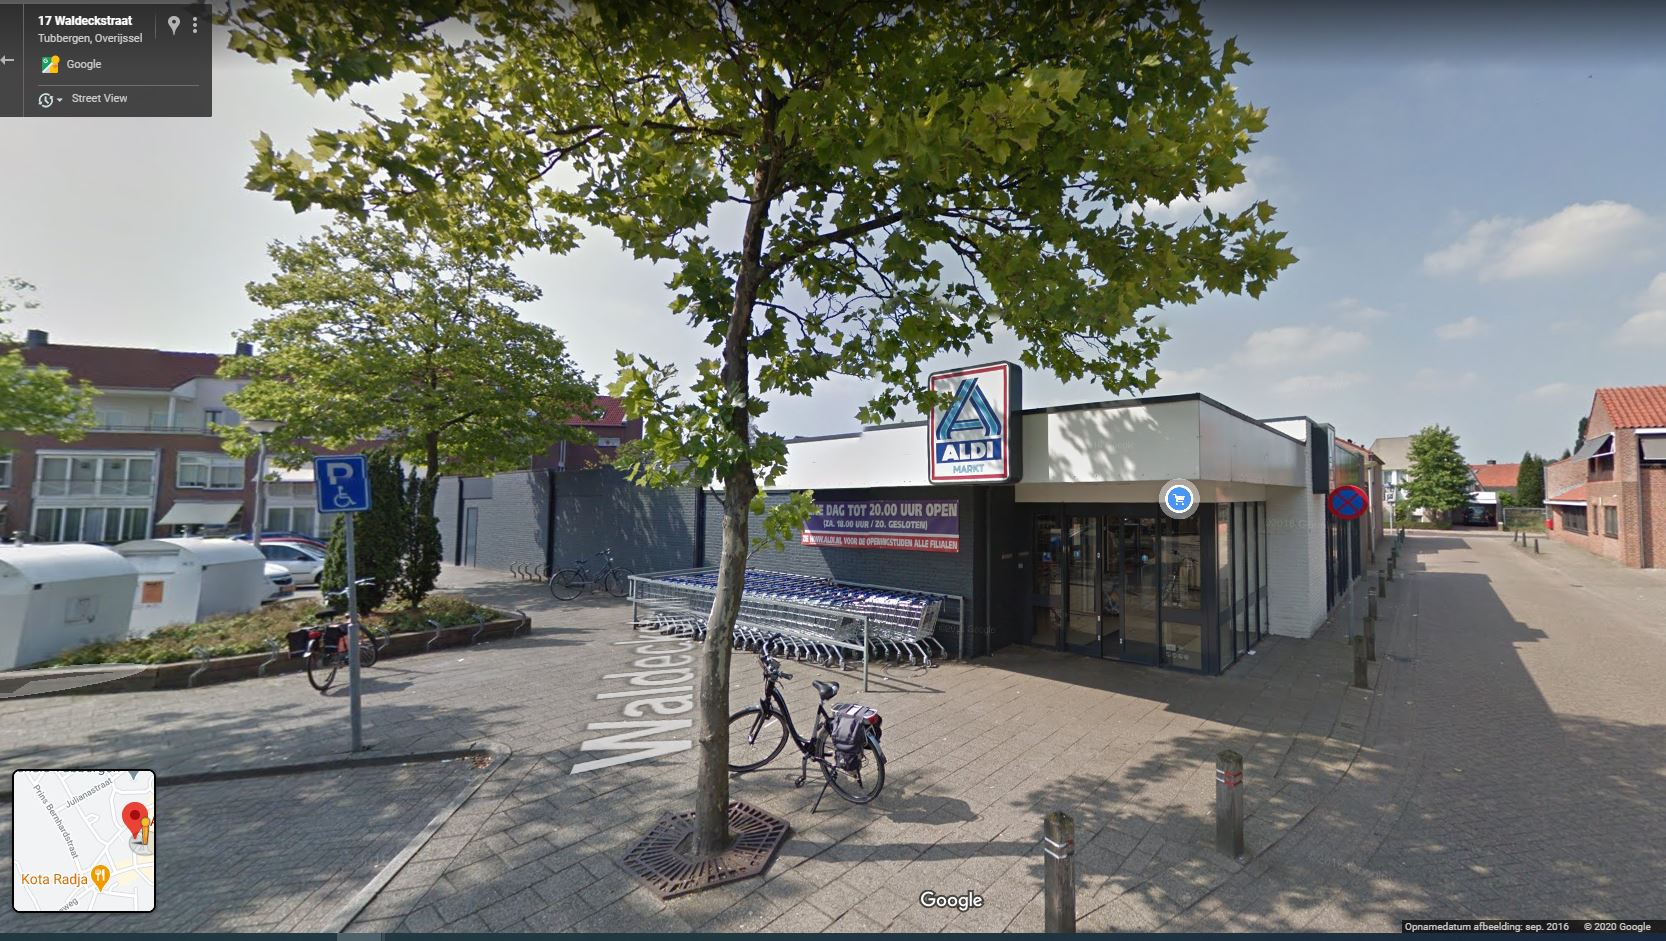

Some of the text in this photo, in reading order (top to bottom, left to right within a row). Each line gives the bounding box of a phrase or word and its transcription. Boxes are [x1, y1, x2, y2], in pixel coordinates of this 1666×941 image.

[941, 441, 994, 462] ALDI
[326, 462, 354, 486] P
[952, 464, 985, 474] MARKT
[826, 503, 845, 517] DAG
[847, 503, 867, 517] TOT
[869, 503, 898, 517] 20.00
[900, 503, 923, 517] UUR
[925, 503, 958, 517] OPEN
[823, 519, 928, 530] (ZA. 18.00 UUR / ZO. GESLOTEN)
[843, 537, 857, 545] VOOR
[858, 537, 866, 545] DE
[914, 539, 929, 548] ALLE
[930, 540, 958, 549] FILIALEN
